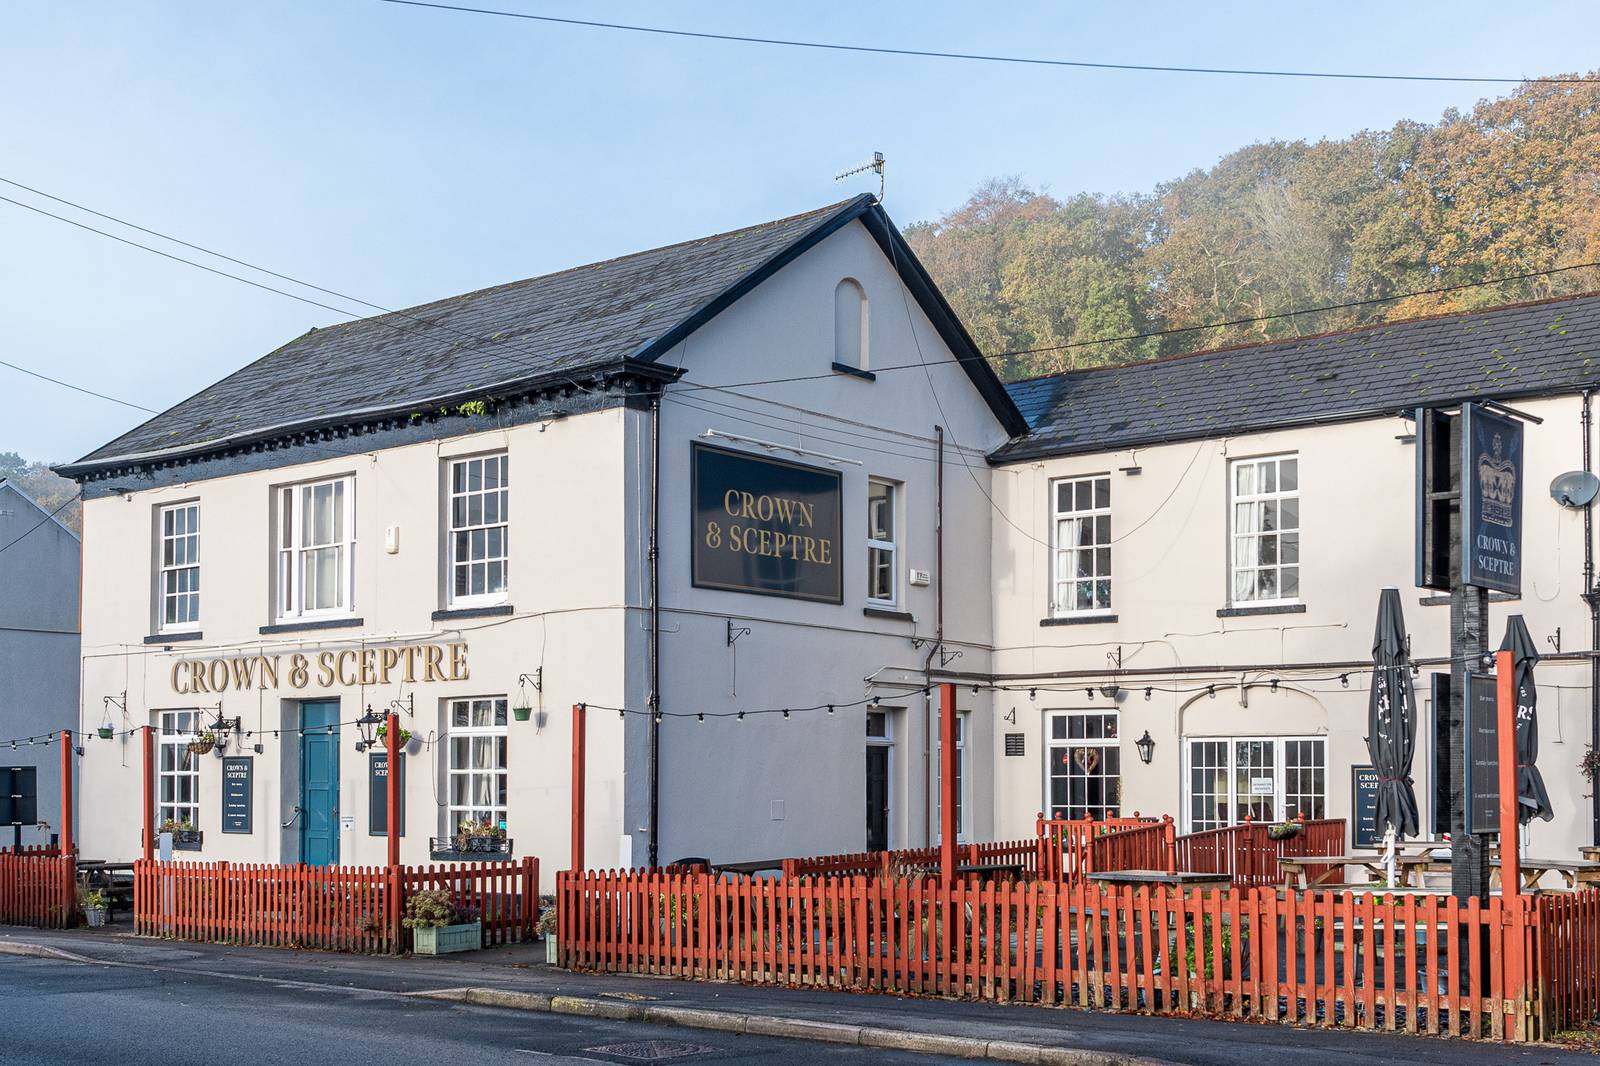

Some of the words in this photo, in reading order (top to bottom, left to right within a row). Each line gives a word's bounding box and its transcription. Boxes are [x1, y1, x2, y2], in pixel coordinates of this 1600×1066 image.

[724, 489, 814, 528] CROWN
[705, 521, 722, 549] &
[729, 524, 832, 564] SCEPTRE
[1477, 534, 1509, 556] CROWN
[1509, 545, 1516, 557] &
[1478, 554, 1514, 576] SCEPTRE
[170, 653, 281, 695] CROWN
[287, 652, 310, 689] &
[316, 641, 471, 688] SCEPTRE
[374, 761, 388, 769] CRO
[375, 769, 388, 777] SCEP
[1359, 774, 1378, 782] CRO
